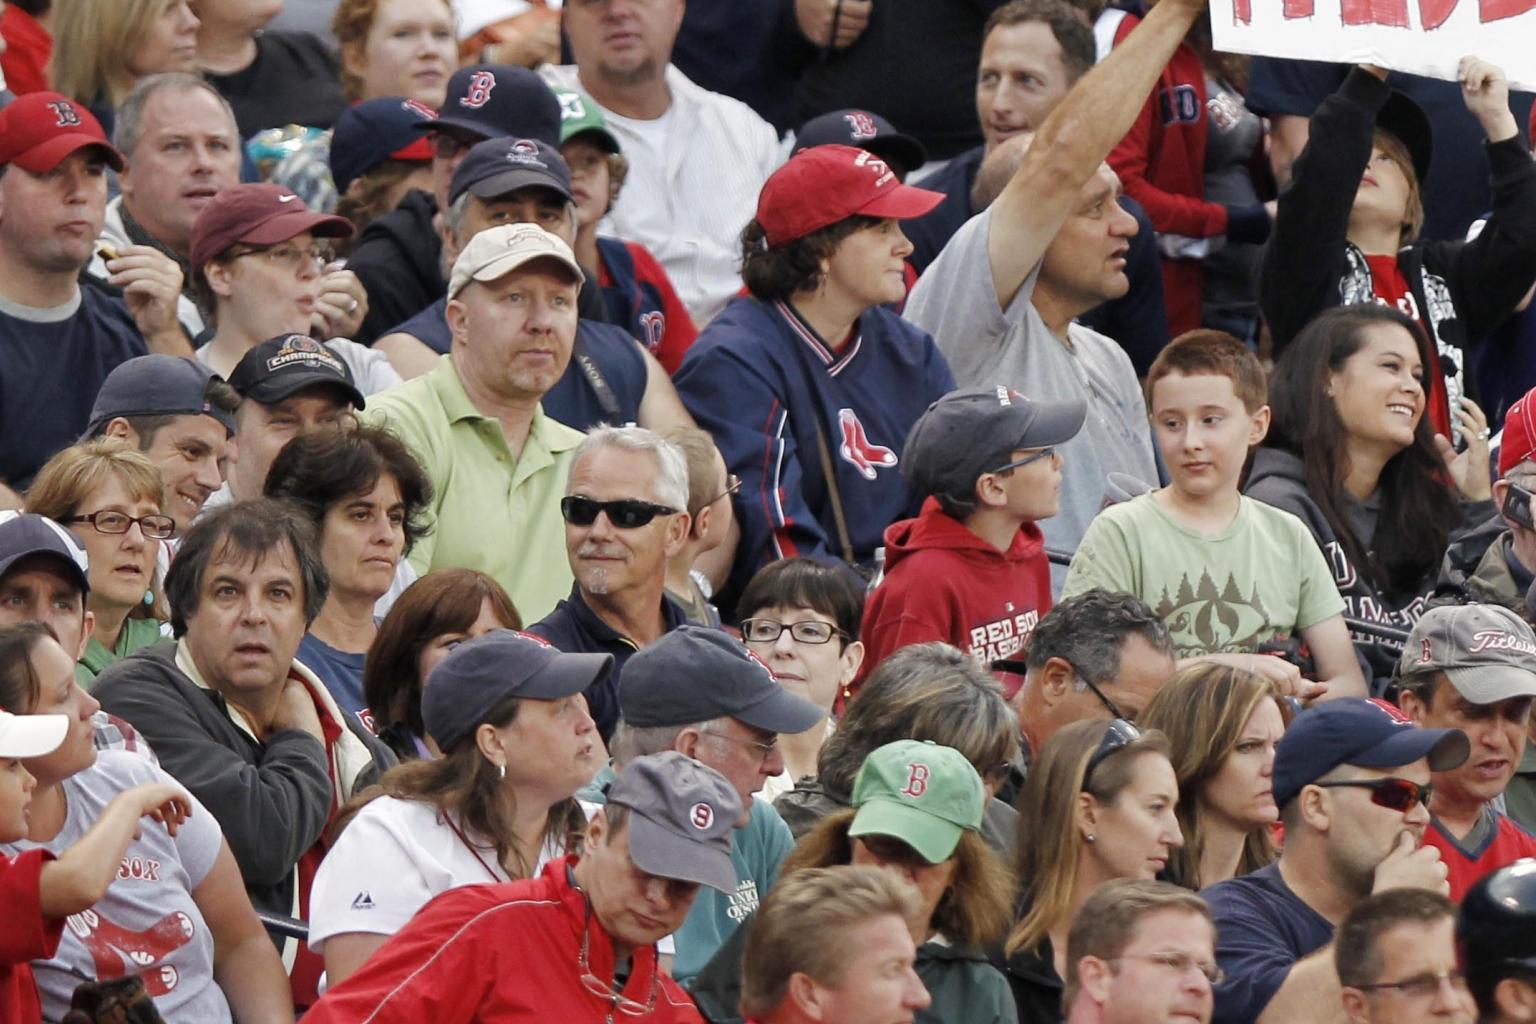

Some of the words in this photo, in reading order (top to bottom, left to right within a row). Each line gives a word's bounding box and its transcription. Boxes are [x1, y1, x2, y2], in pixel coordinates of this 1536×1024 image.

[461, 71, 495, 108] B
[48, 101, 81, 126] B
[844, 112, 877, 140] B
[970, 619, 1013, 649] RED
[1416, 638, 1432, 664] B
[900, 763, 931, 798] B
[119, 857, 161, 882] SOX
